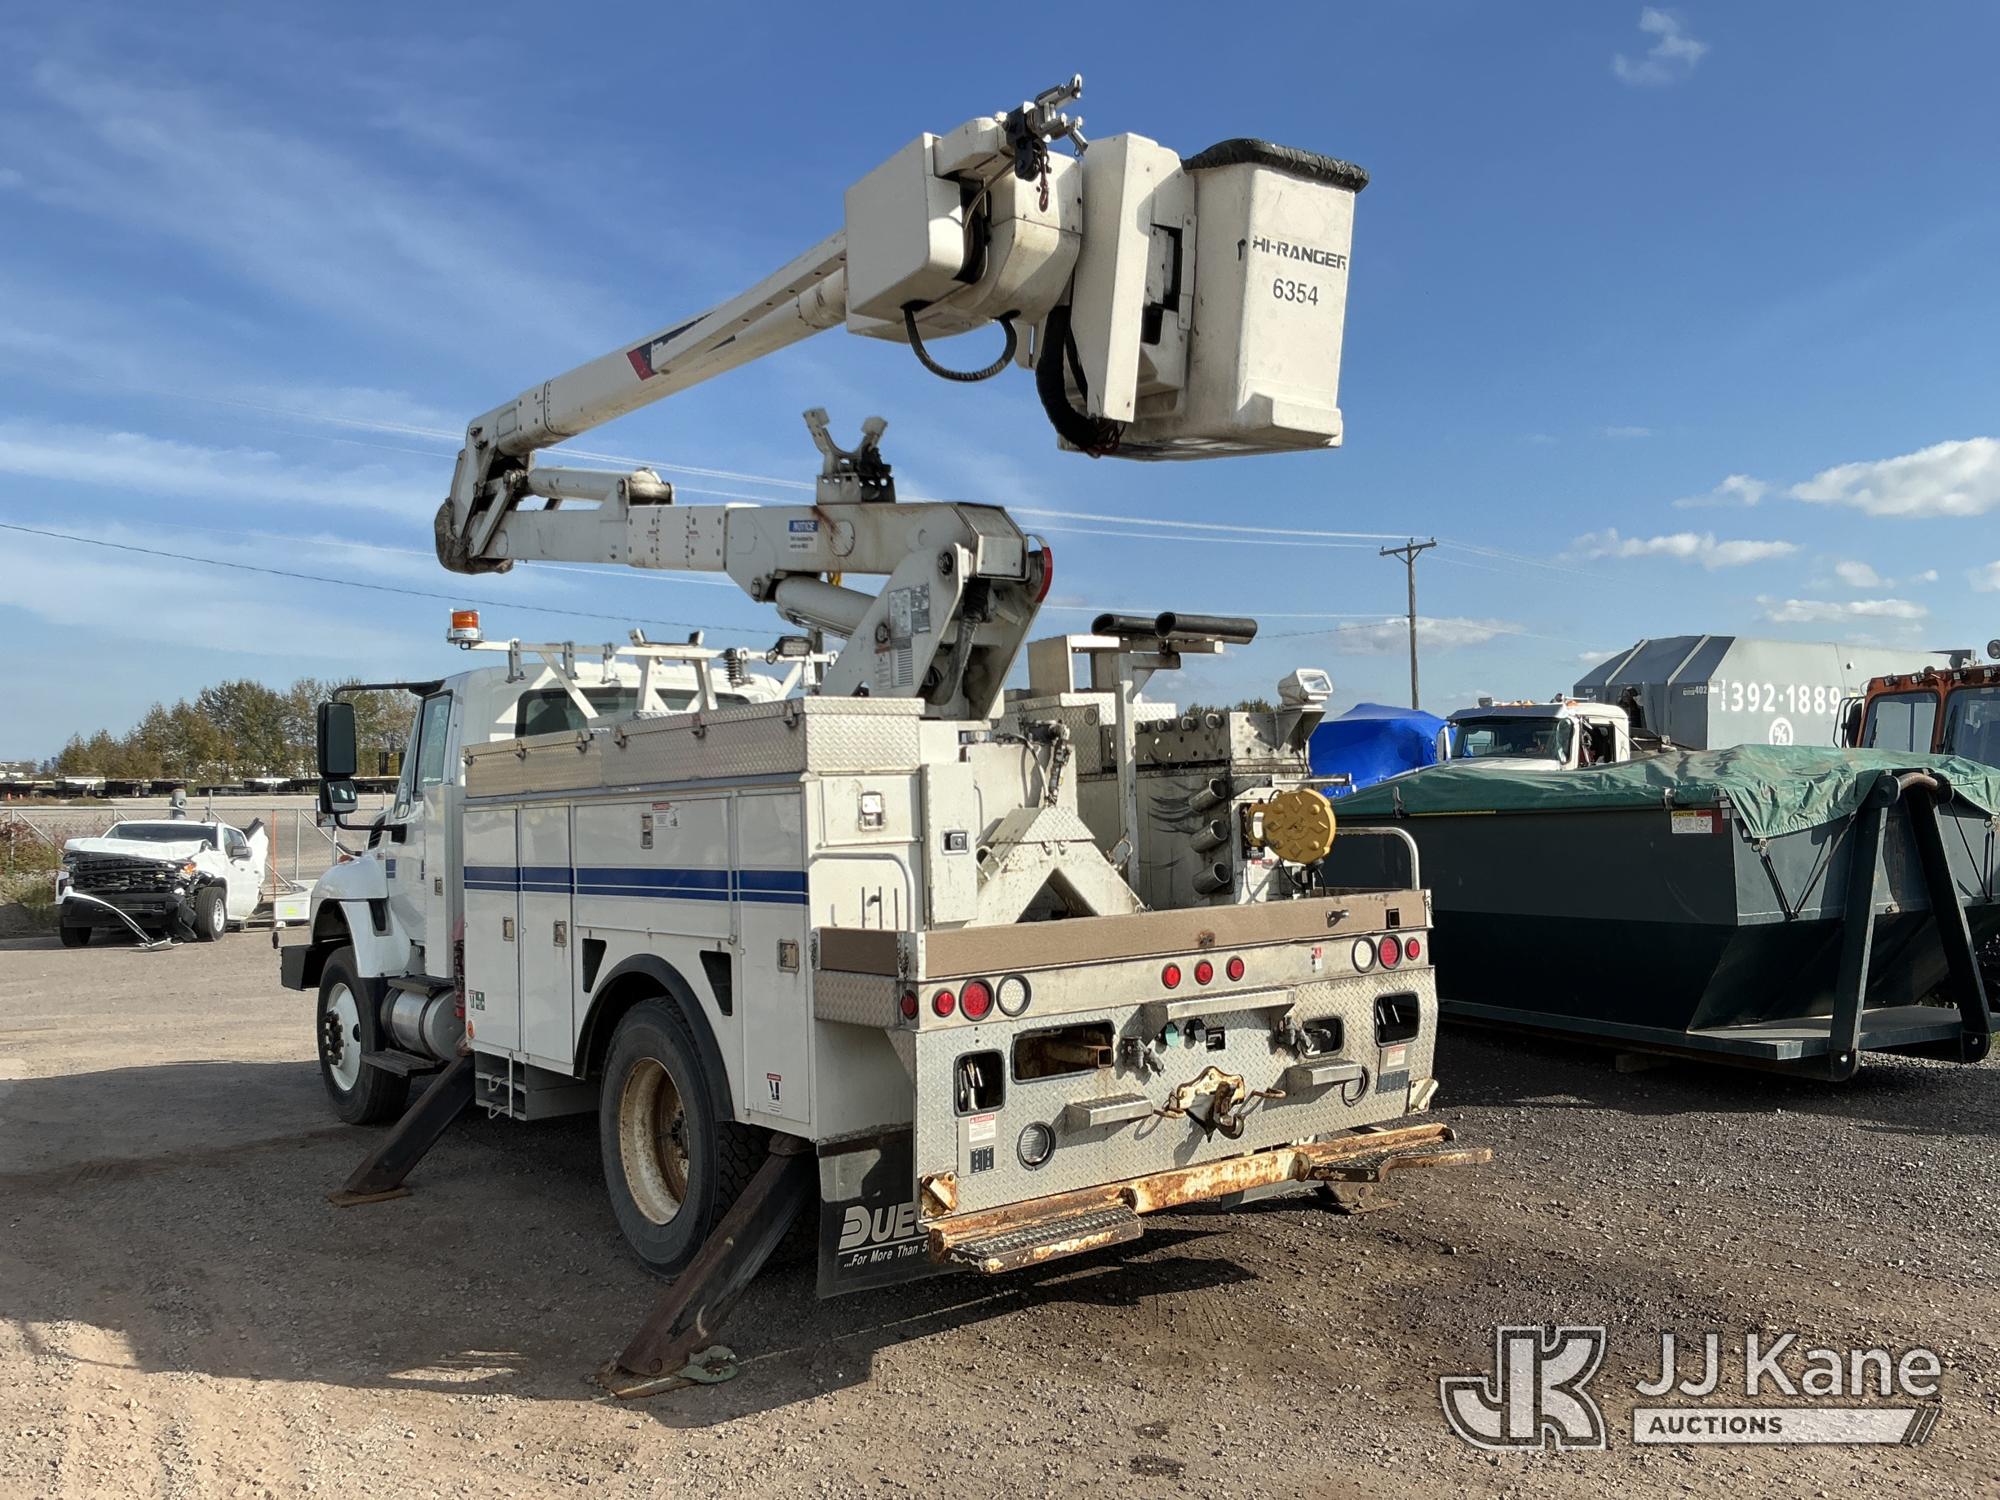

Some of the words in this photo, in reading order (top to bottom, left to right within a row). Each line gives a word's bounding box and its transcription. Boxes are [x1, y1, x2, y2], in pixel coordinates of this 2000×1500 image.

[1252, 236, 1347, 270] HI-RANGER
[1272, 278, 1319, 306] 6354
[870, 1248, 893, 1263] More
[897, 1243, 919, 1259] Than
